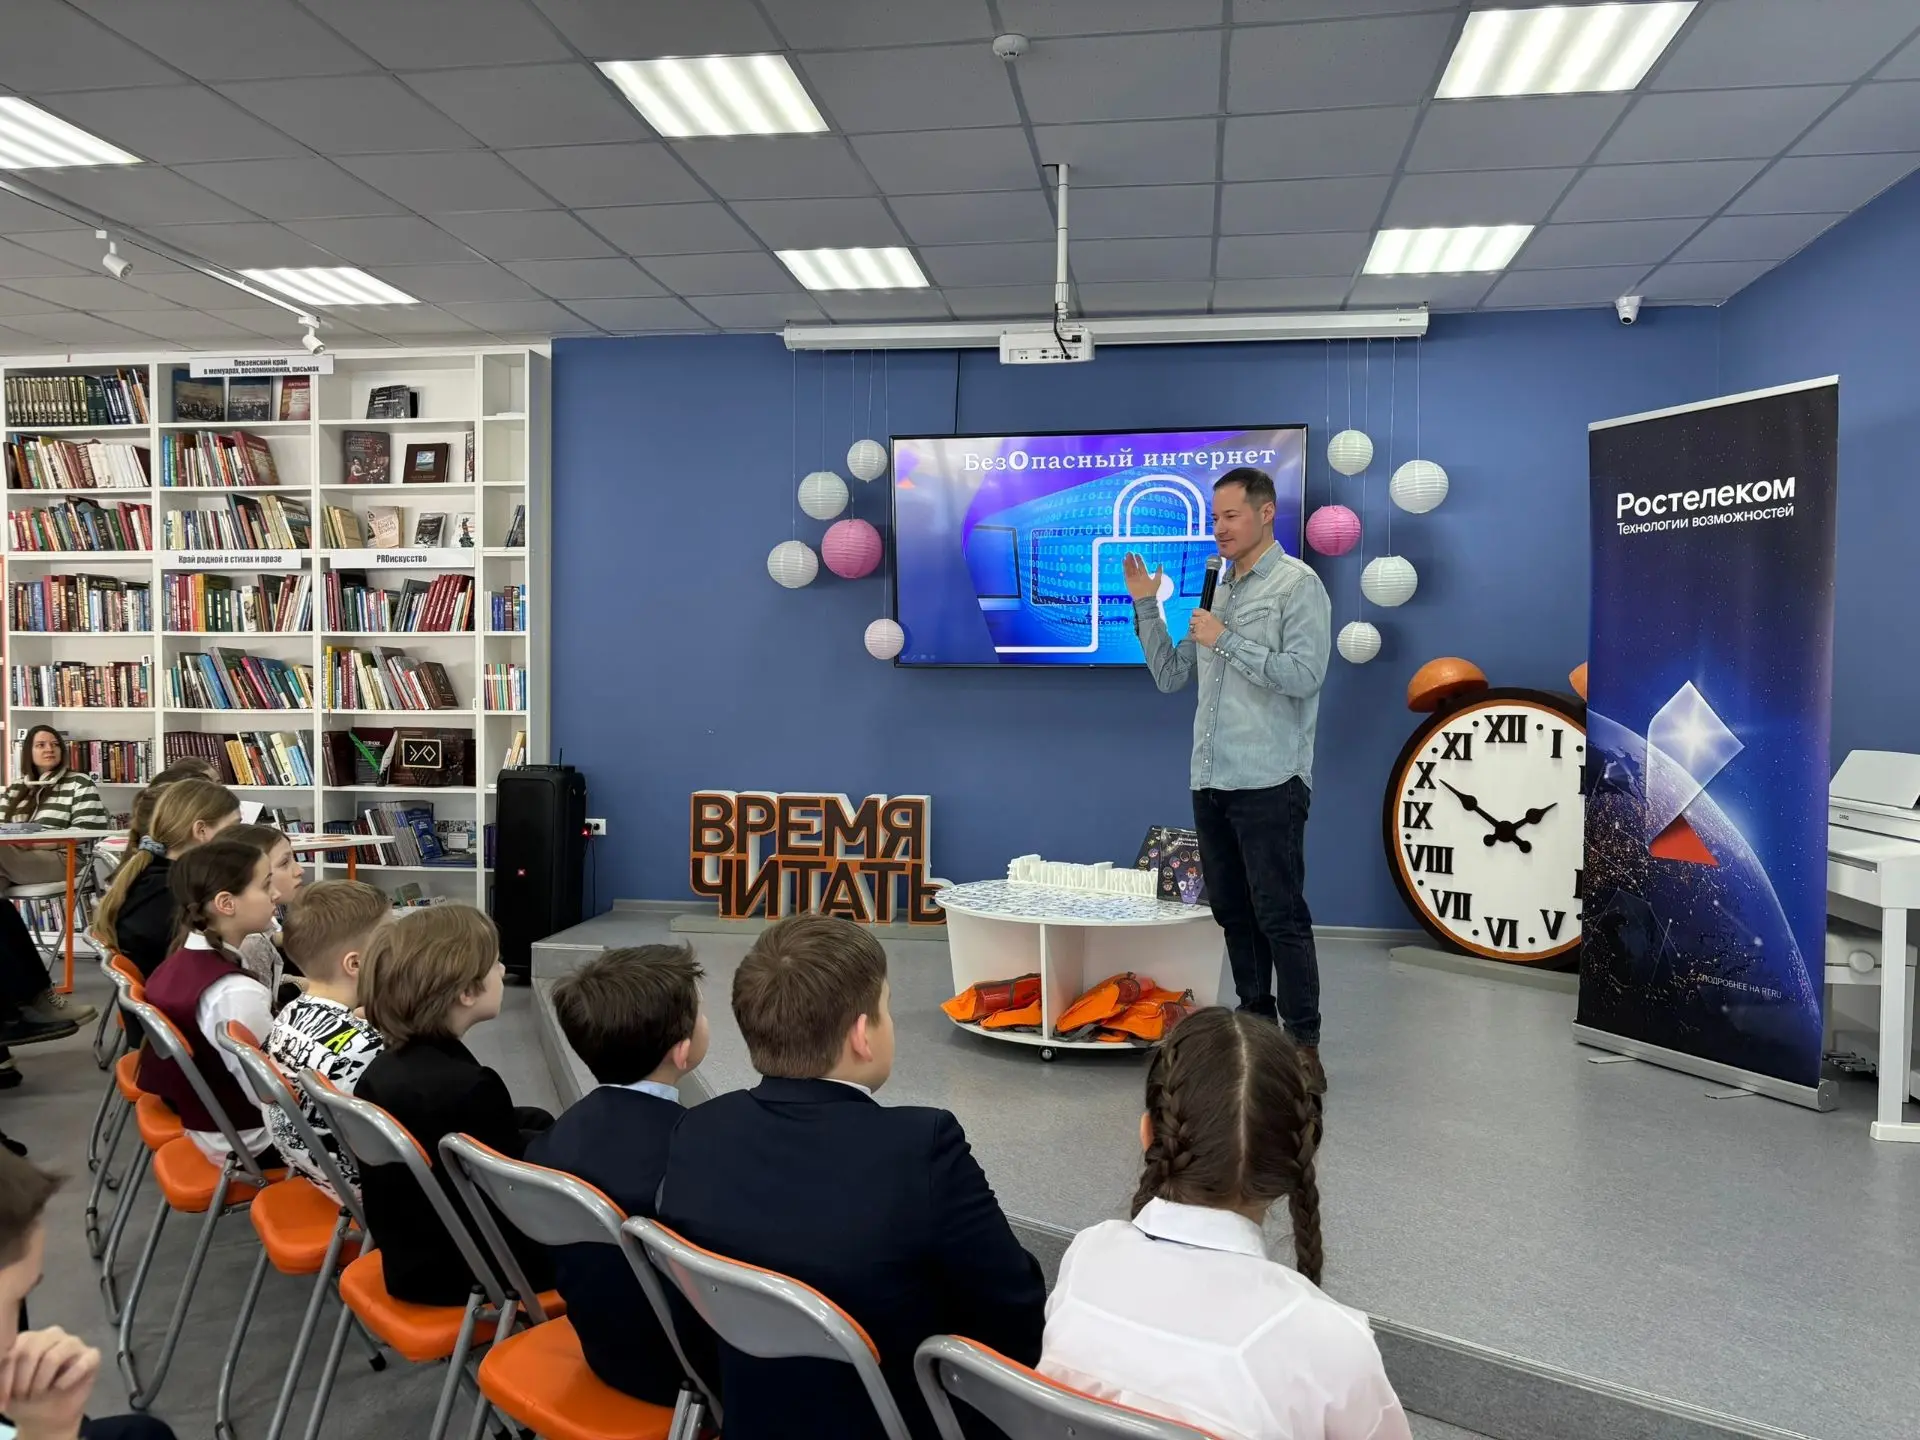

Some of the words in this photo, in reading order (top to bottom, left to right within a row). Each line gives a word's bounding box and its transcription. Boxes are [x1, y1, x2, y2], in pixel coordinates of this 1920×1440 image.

[234, 358, 272, 366] Пензенский
[272, 358, 288, 367] край
[292, 365, 319, 373] письмах
[963, 447, 1134, 472] БезОпасный
[1143, 448, 1276, 472] интернет
[1616, 477, 1796, 519] Ростелеком
[1616, 515, 1689, 536] Технологии
[1692, 502, 1795, 527] возможностей
[178, 555, 195, 564] Край
[196, 555, 223, 564] родной
[261, 556, 282, 564] прозе
[376, 554, 427, 563] PROискусство
[1484, 714, 1528, 744] XII
[1550, 729, 1564, 759] I
[1440, 732, 1473, 761] XI
[1414, 761, 1437, 790] X
[690, 792, 929, 860] ВРЕМЯ
[1403, 801, 1433, 830] IX
[1404, 843, 1454, 875] VIII
[690, 857, 948, 925] ЧИТАТЬ
[1430, 889, 1472, 922] VII
[1484, 917, 1519, 949] VI
[1539, 909, 1567, 941] V
[1749, 984, 1761, 993] НА
